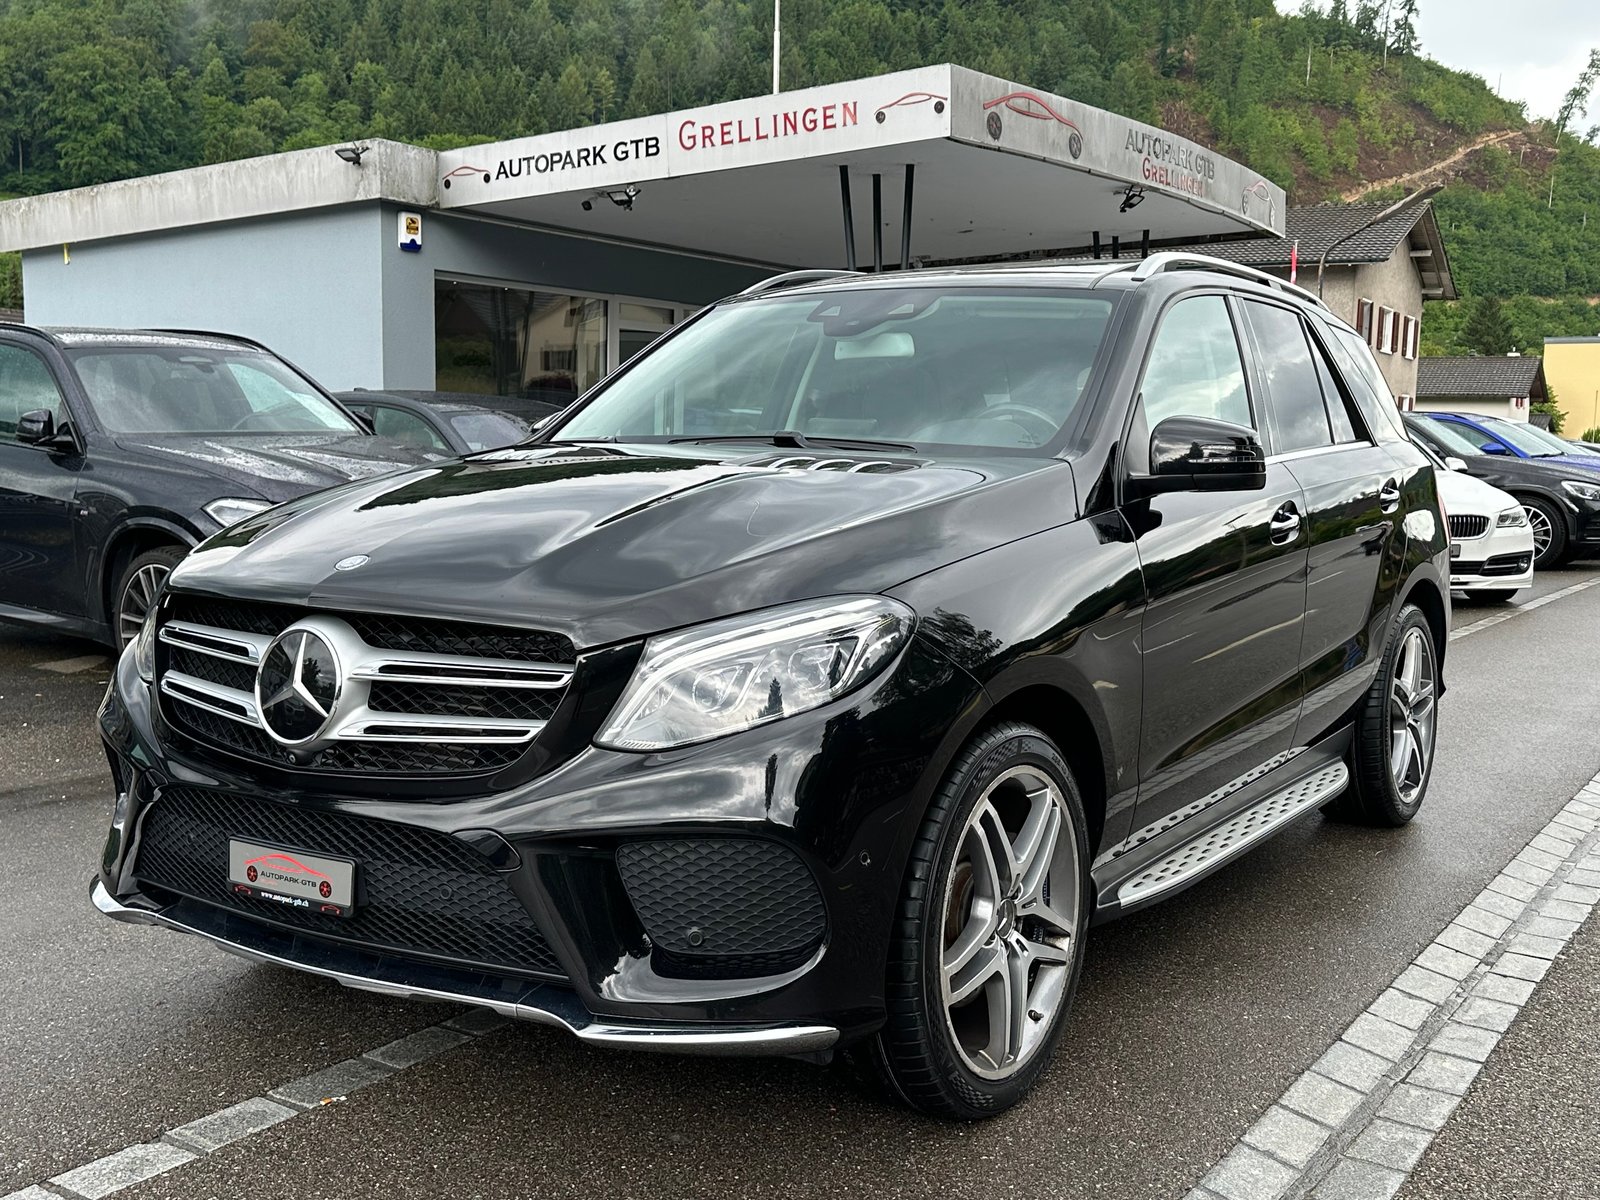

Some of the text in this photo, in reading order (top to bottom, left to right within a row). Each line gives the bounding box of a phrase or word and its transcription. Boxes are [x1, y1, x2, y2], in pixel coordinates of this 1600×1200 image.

[678, 101, 858, 151] GRELLINGEN
[495, 136, 660, 180] AUTOPARK GTB
[1125, 129, 1215, 180] AUTOPARK GTB
[1142, 157, 1203, 198] GRELLINGEN
